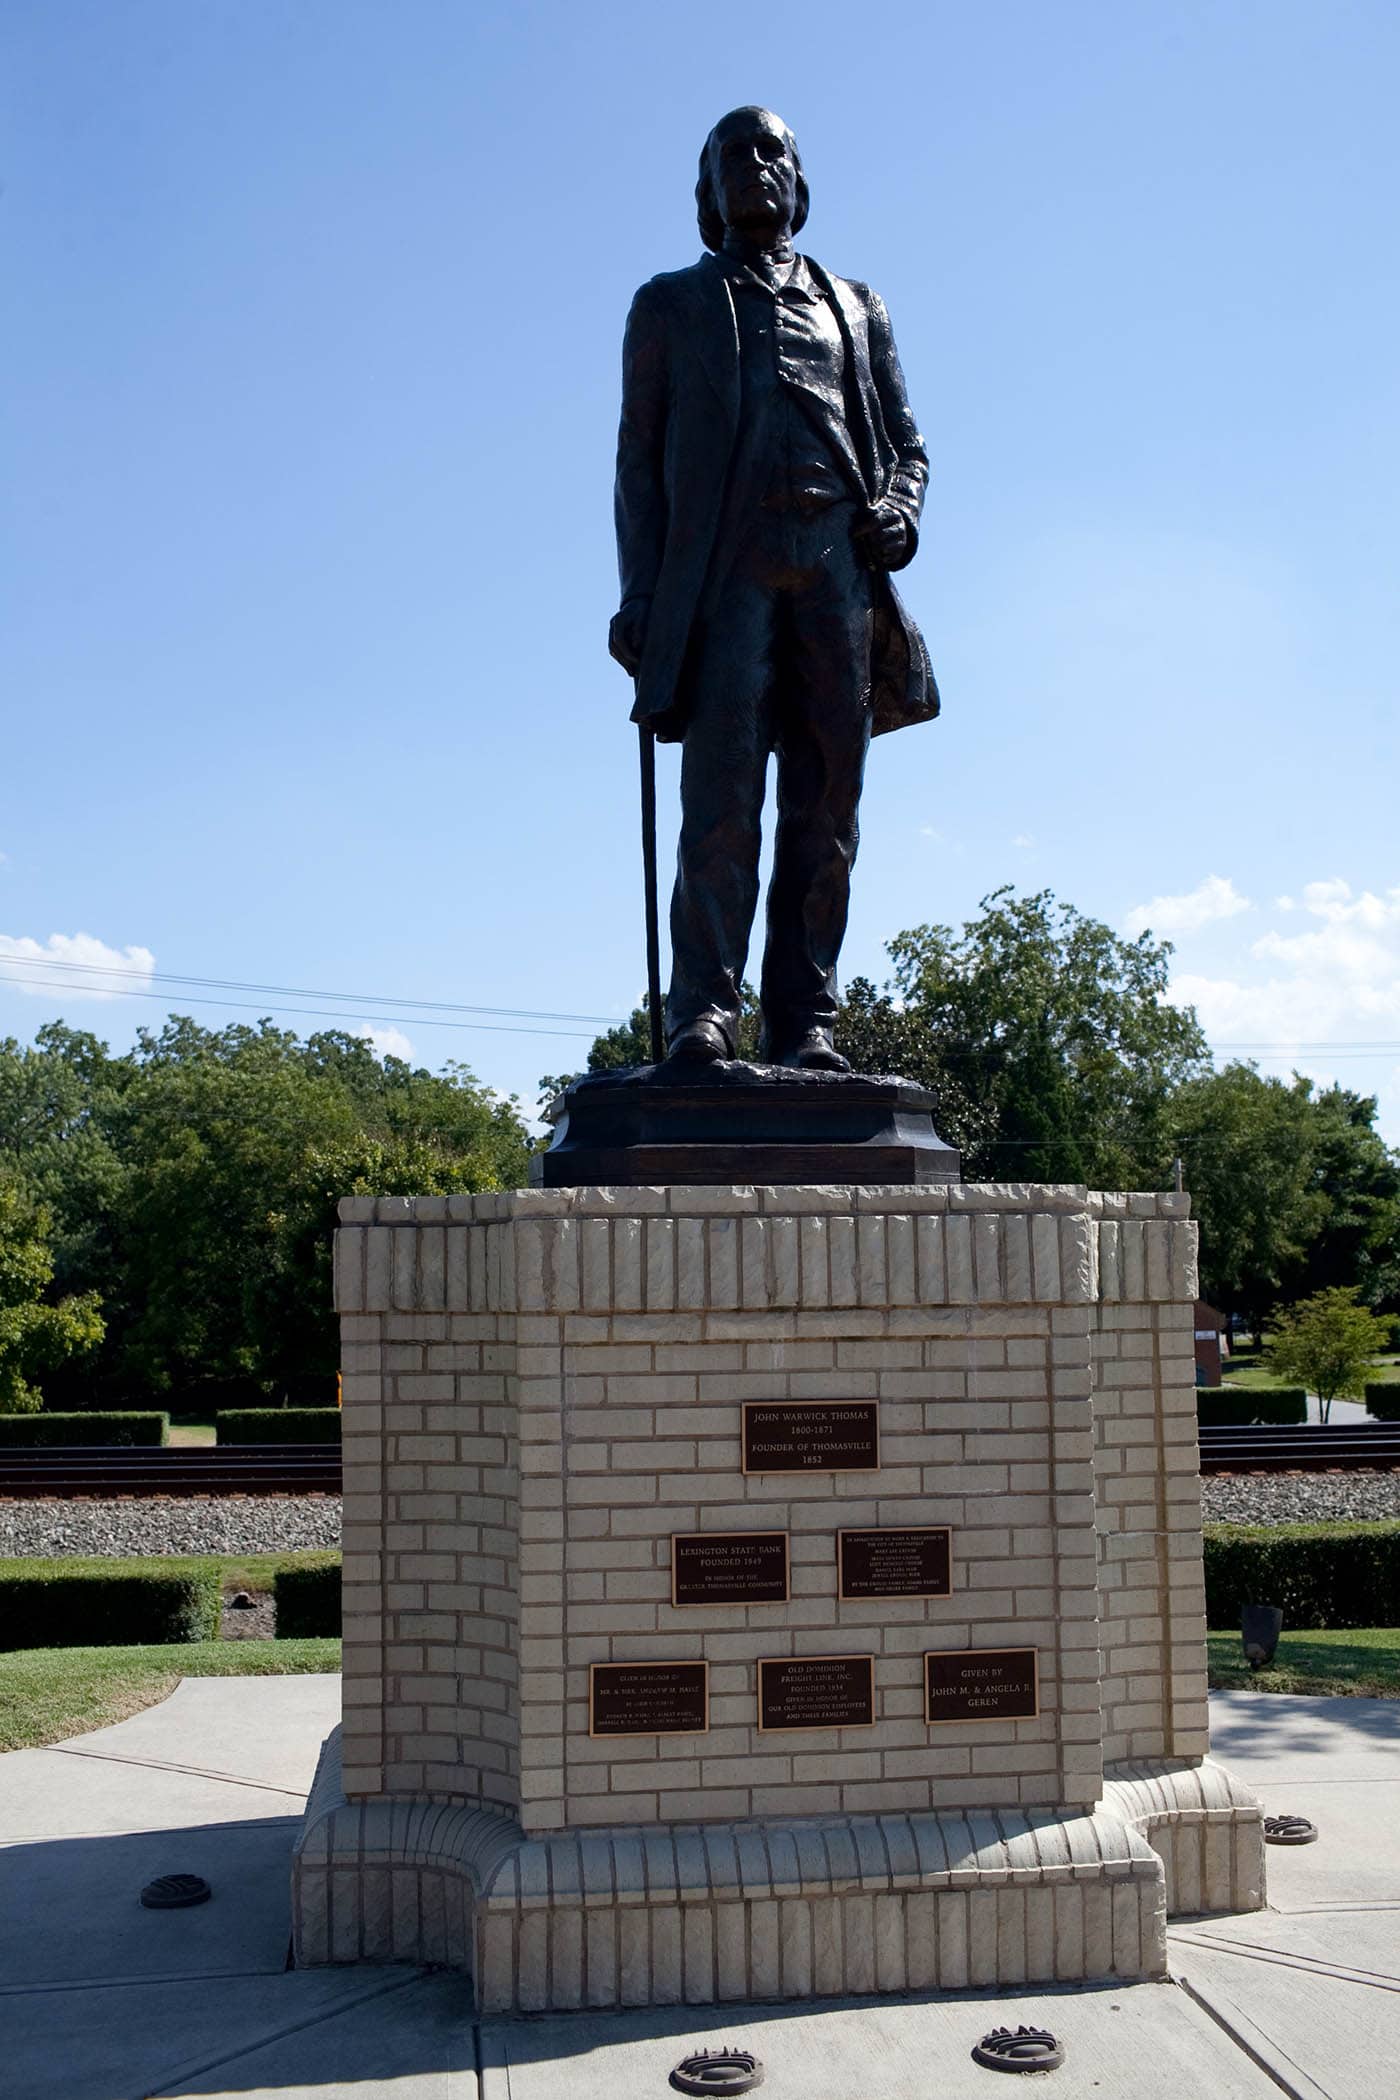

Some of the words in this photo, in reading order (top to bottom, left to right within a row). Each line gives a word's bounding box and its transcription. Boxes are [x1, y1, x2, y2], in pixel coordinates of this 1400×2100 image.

[754, 1412, 779, 1423] JOHN
[782, 1412, 827, 1421] WARWICK
[830, 1411, 869, 1420] THOMAS
[791, 1426, 832, 1434] 1800-1871
[752, 1443, 793, 1452] FOUNDER
[797, 1443, 808, 1451] OF
[812, 1442, 871, 1450] THOMASVILLE
[803, 1455, 822, 1464] 1852
[680, 1548, 728, 1556] LEXINGTON
[731, 1547, 756, 1555] STATE
[701, 1558, 741, 1567] FOUNDED
[806, 1664, 846, 1672] DOMINION
[961, 1669, 988, 1678] GIVEN
[991, 1668, 1003, 1676] BY
[781, 1675, 812, 1683] FREIGHT
[791, 1685, 826, 1693] FOUNDED
[932, 1687, 957, 1698] JOHN
[959, 1686, 971, 1695] M.
[974, 1686, 981, 1694] &
[984, 1684, 1020, 1693] ANGELA
[968, 1697, 999, 1707] GEREN
